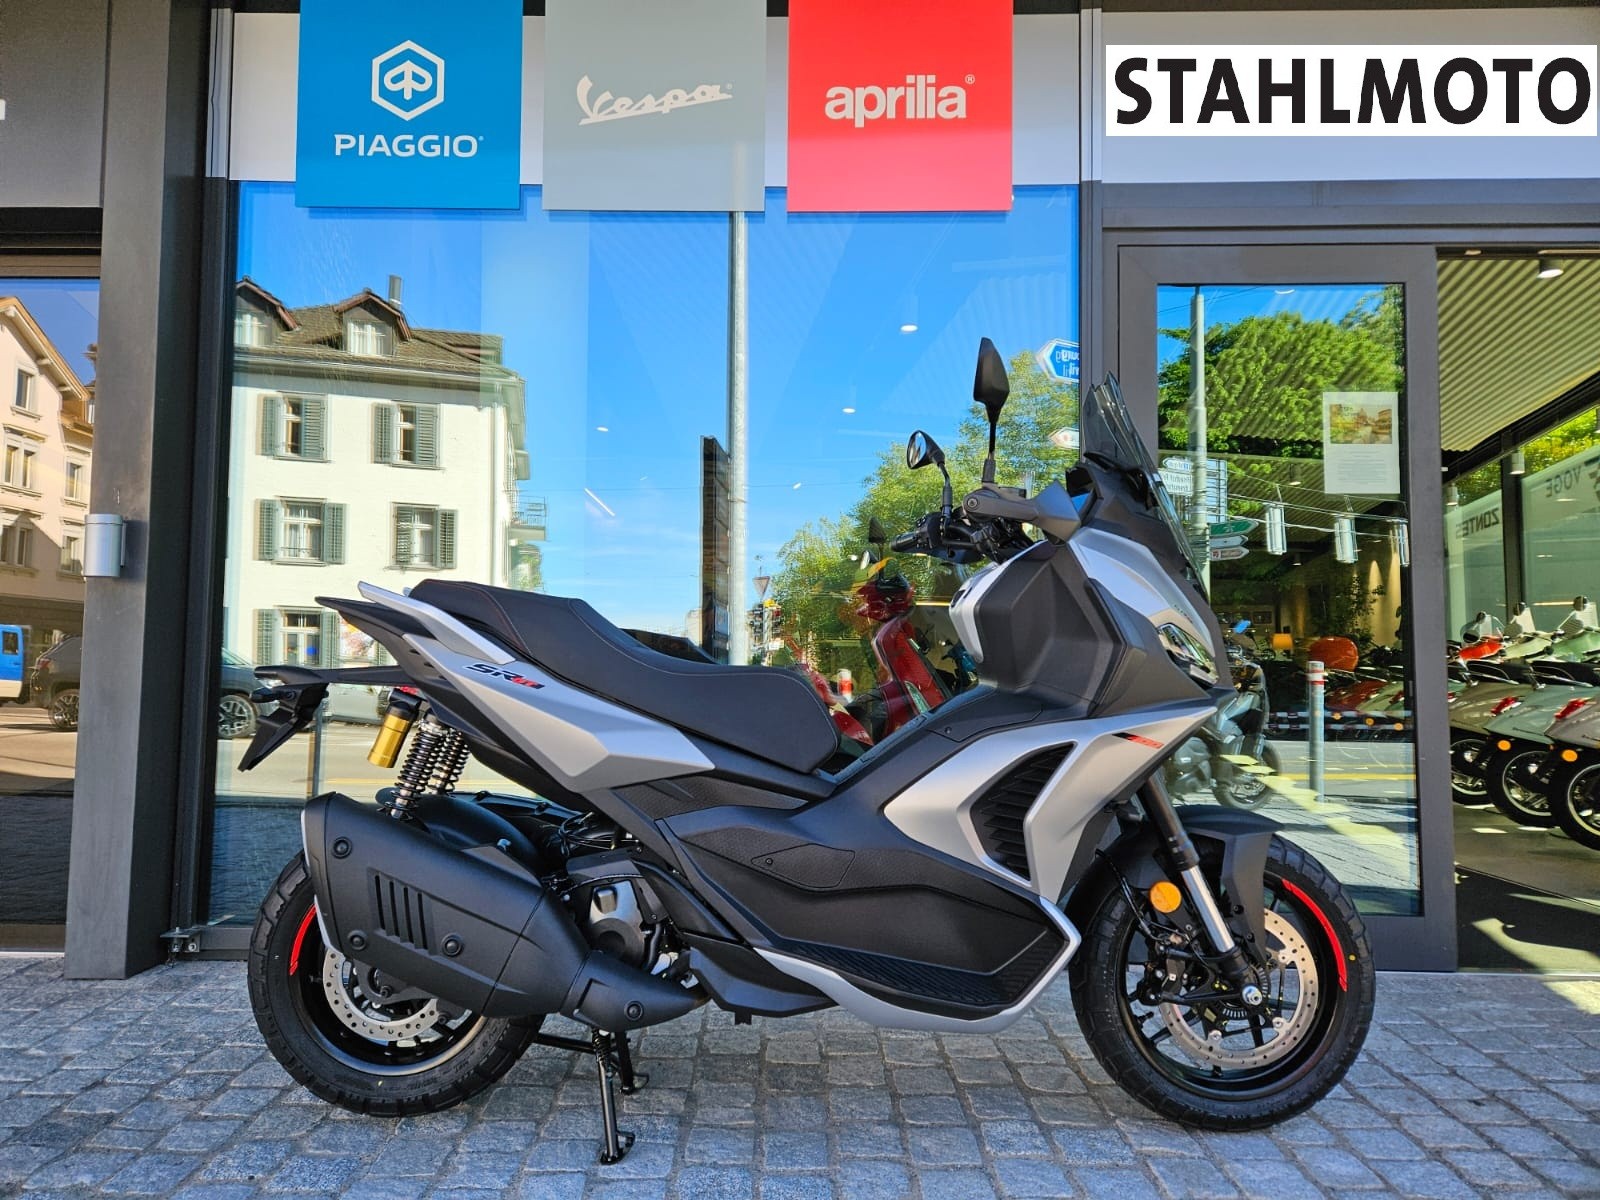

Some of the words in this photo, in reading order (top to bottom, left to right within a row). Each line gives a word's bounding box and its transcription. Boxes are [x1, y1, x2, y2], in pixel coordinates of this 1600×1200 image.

[576, 75, 733, 125] Vespa
[825, 74, 967, 128] aprilia
[334, 134, 478, 158] PIAGGIO
